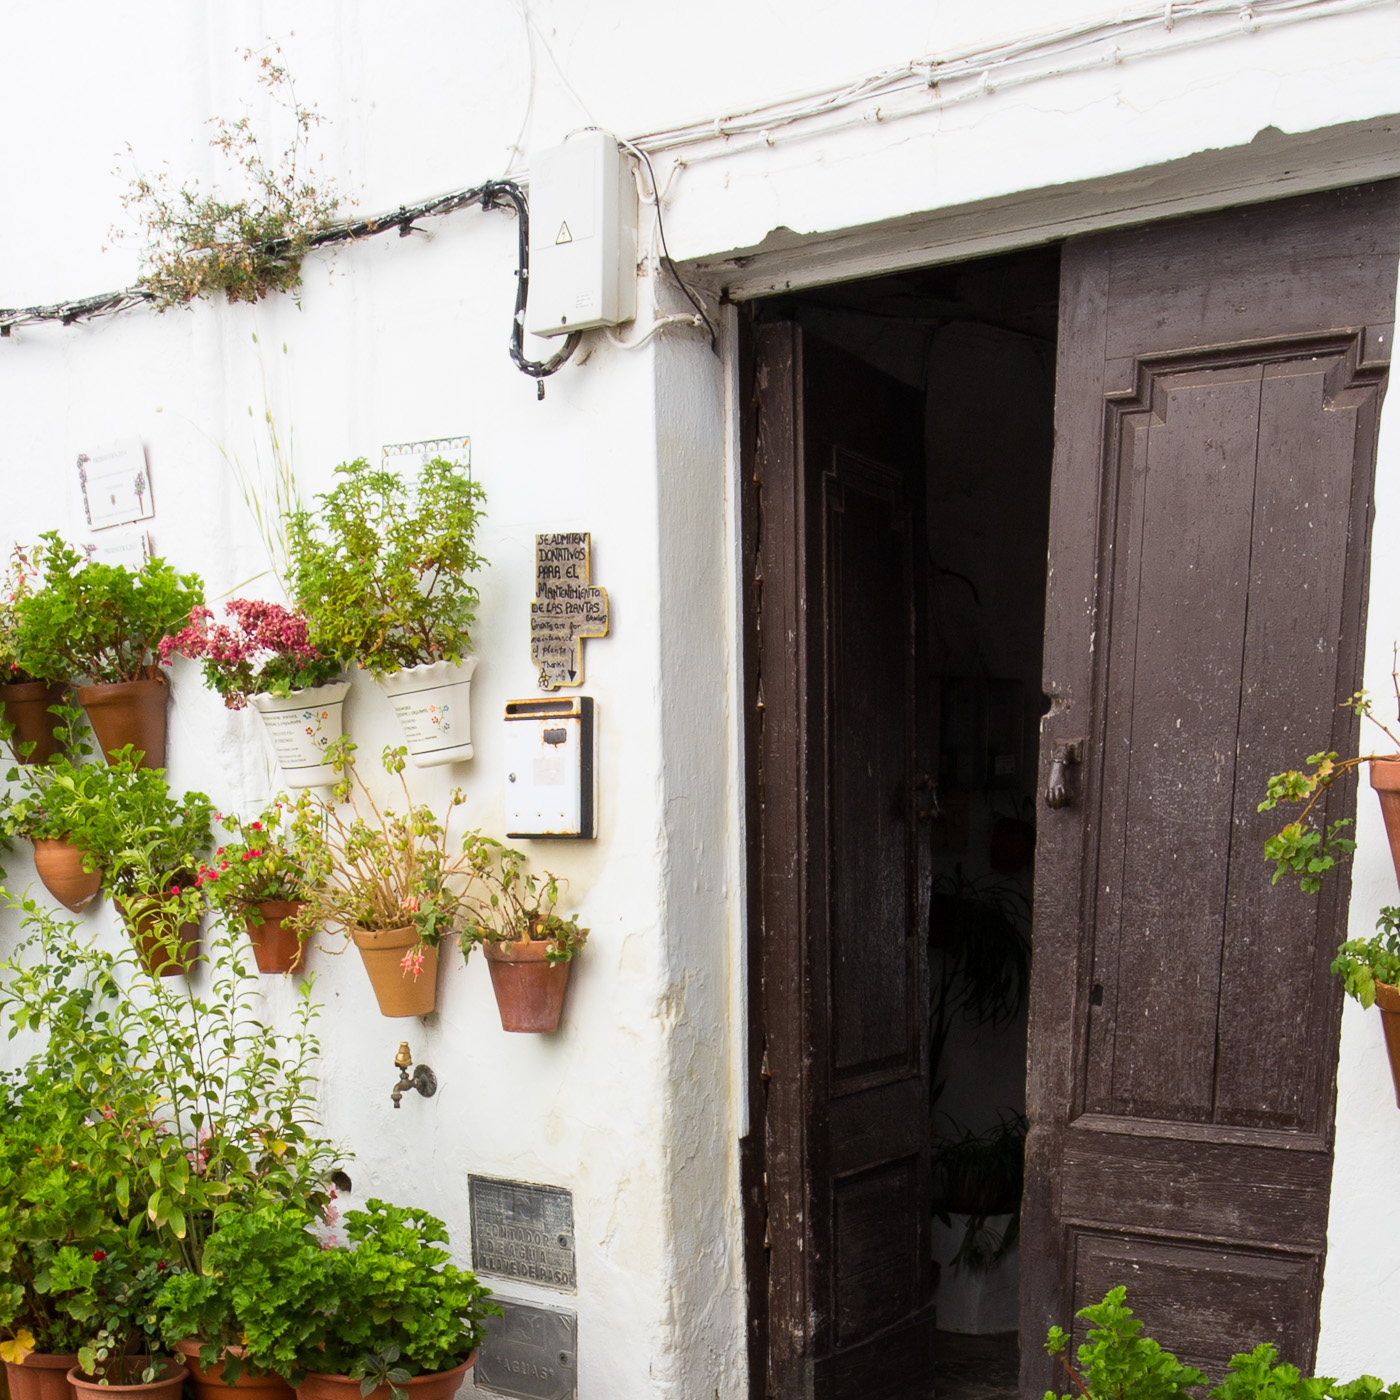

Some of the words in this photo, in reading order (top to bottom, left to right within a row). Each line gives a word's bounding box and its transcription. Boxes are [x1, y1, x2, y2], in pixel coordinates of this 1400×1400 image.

[537, 533, 549, 545] SE
[549, 532, 588, 545] ADMITEN
[538, 547, 586, 562] DONATIVOS
[537, 565, 561, 579] PARA
[565, 563, 579, 579] EL
[531, 602, 544, 613] DE
[546, 602, 563, 614] LAS
[565, 601, 600, 614] PLANTAS
[485, 1222, 551, 1248] CONTADOR
[482, 1254, 518, 1275] LLAVE
[521, 1262, 537, 1279] DE
[540, 1265, 570, 1285] PASO
